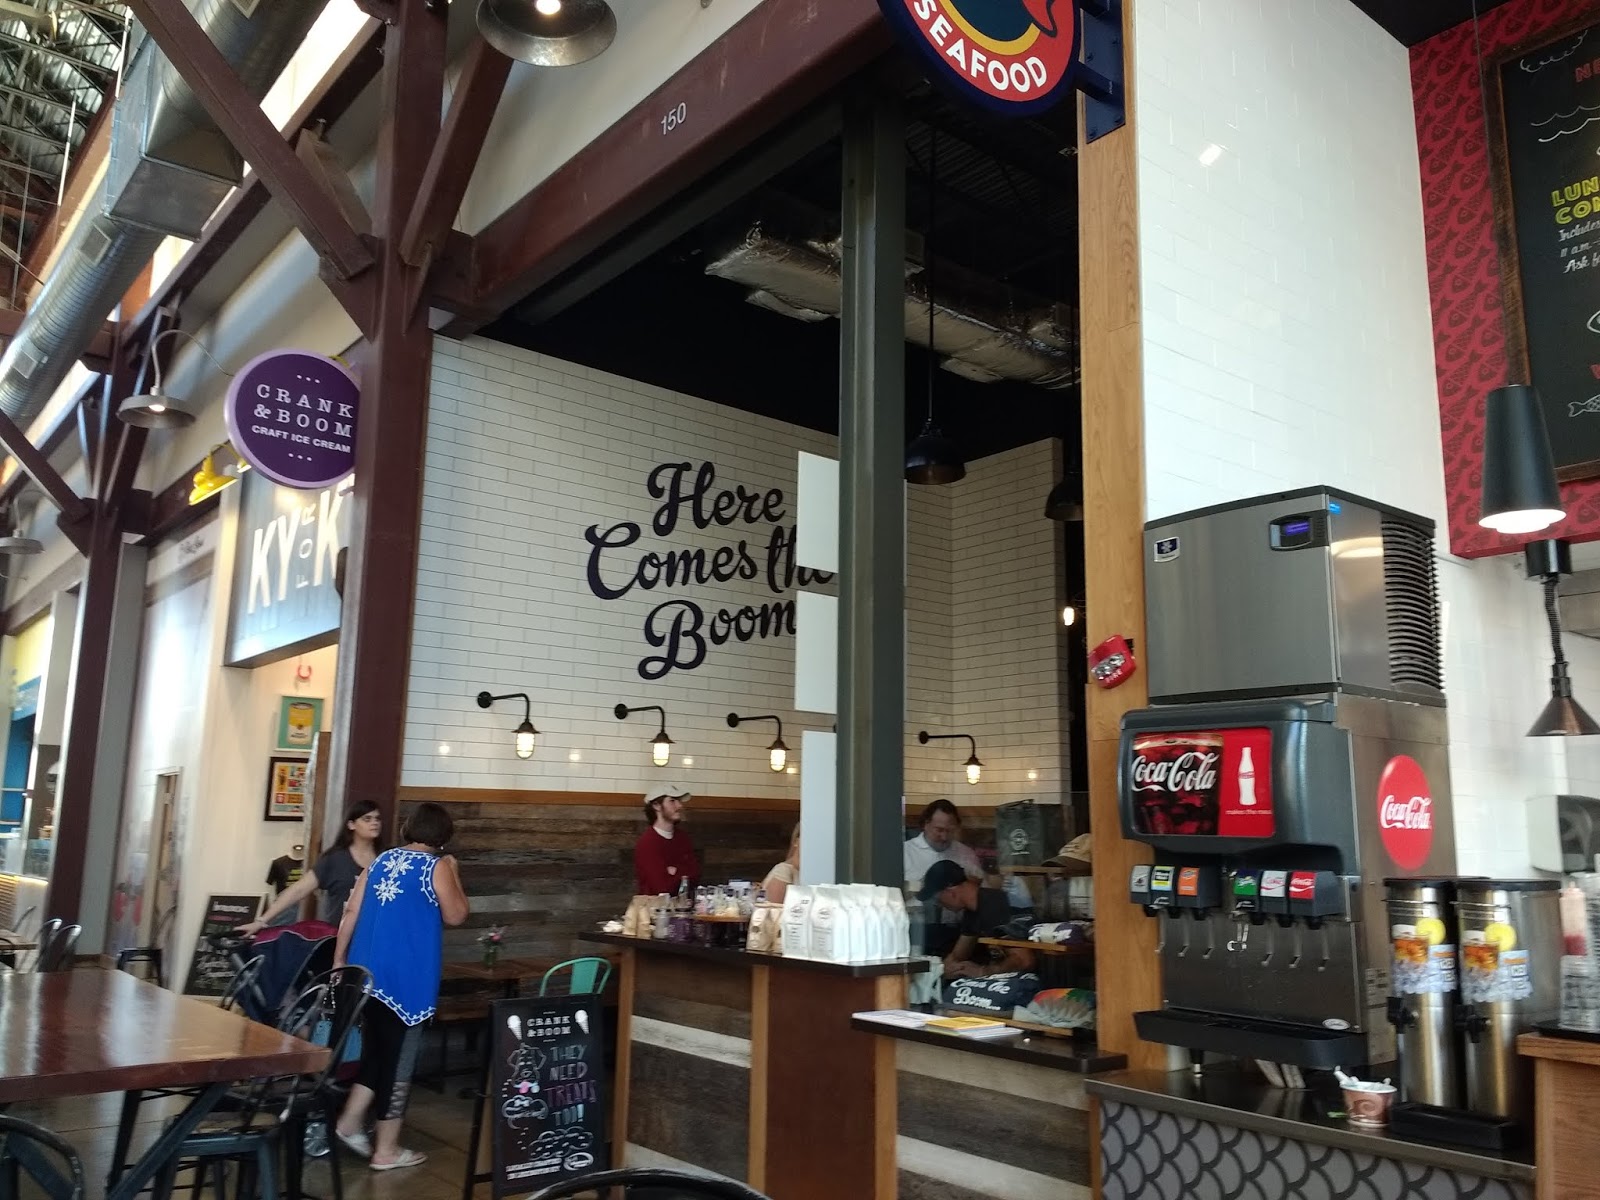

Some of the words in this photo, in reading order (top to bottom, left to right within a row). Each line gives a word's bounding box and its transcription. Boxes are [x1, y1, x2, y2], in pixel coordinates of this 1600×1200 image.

[914, 0, 1047, 93] SEAFOOD
[660, 102, 687, 135] 150
[1551, 176, 1600, 207] LUN
[256, 384, 354, 418] CRANK
[253, 403, 272, 419] &
[276, 408, 352, 438] BOOM
[251, 424, 289, 440] CRAFT
[290, 433, 310, 444] ICE
[312, 438, 351, 453] CREAM
[647, 461, 786, 537] Here
[247, 506, 302, 614] KY
[313, 473, 356, 587] K
[584, 522, 757, 600] Comes
[637, 599, 797, 680] Boom
[1131, 751, 1220, 792] Coca-Cola
[526, 1015, 571, 1027] CRANK
[549, 1061, 588, 1081] NEED
